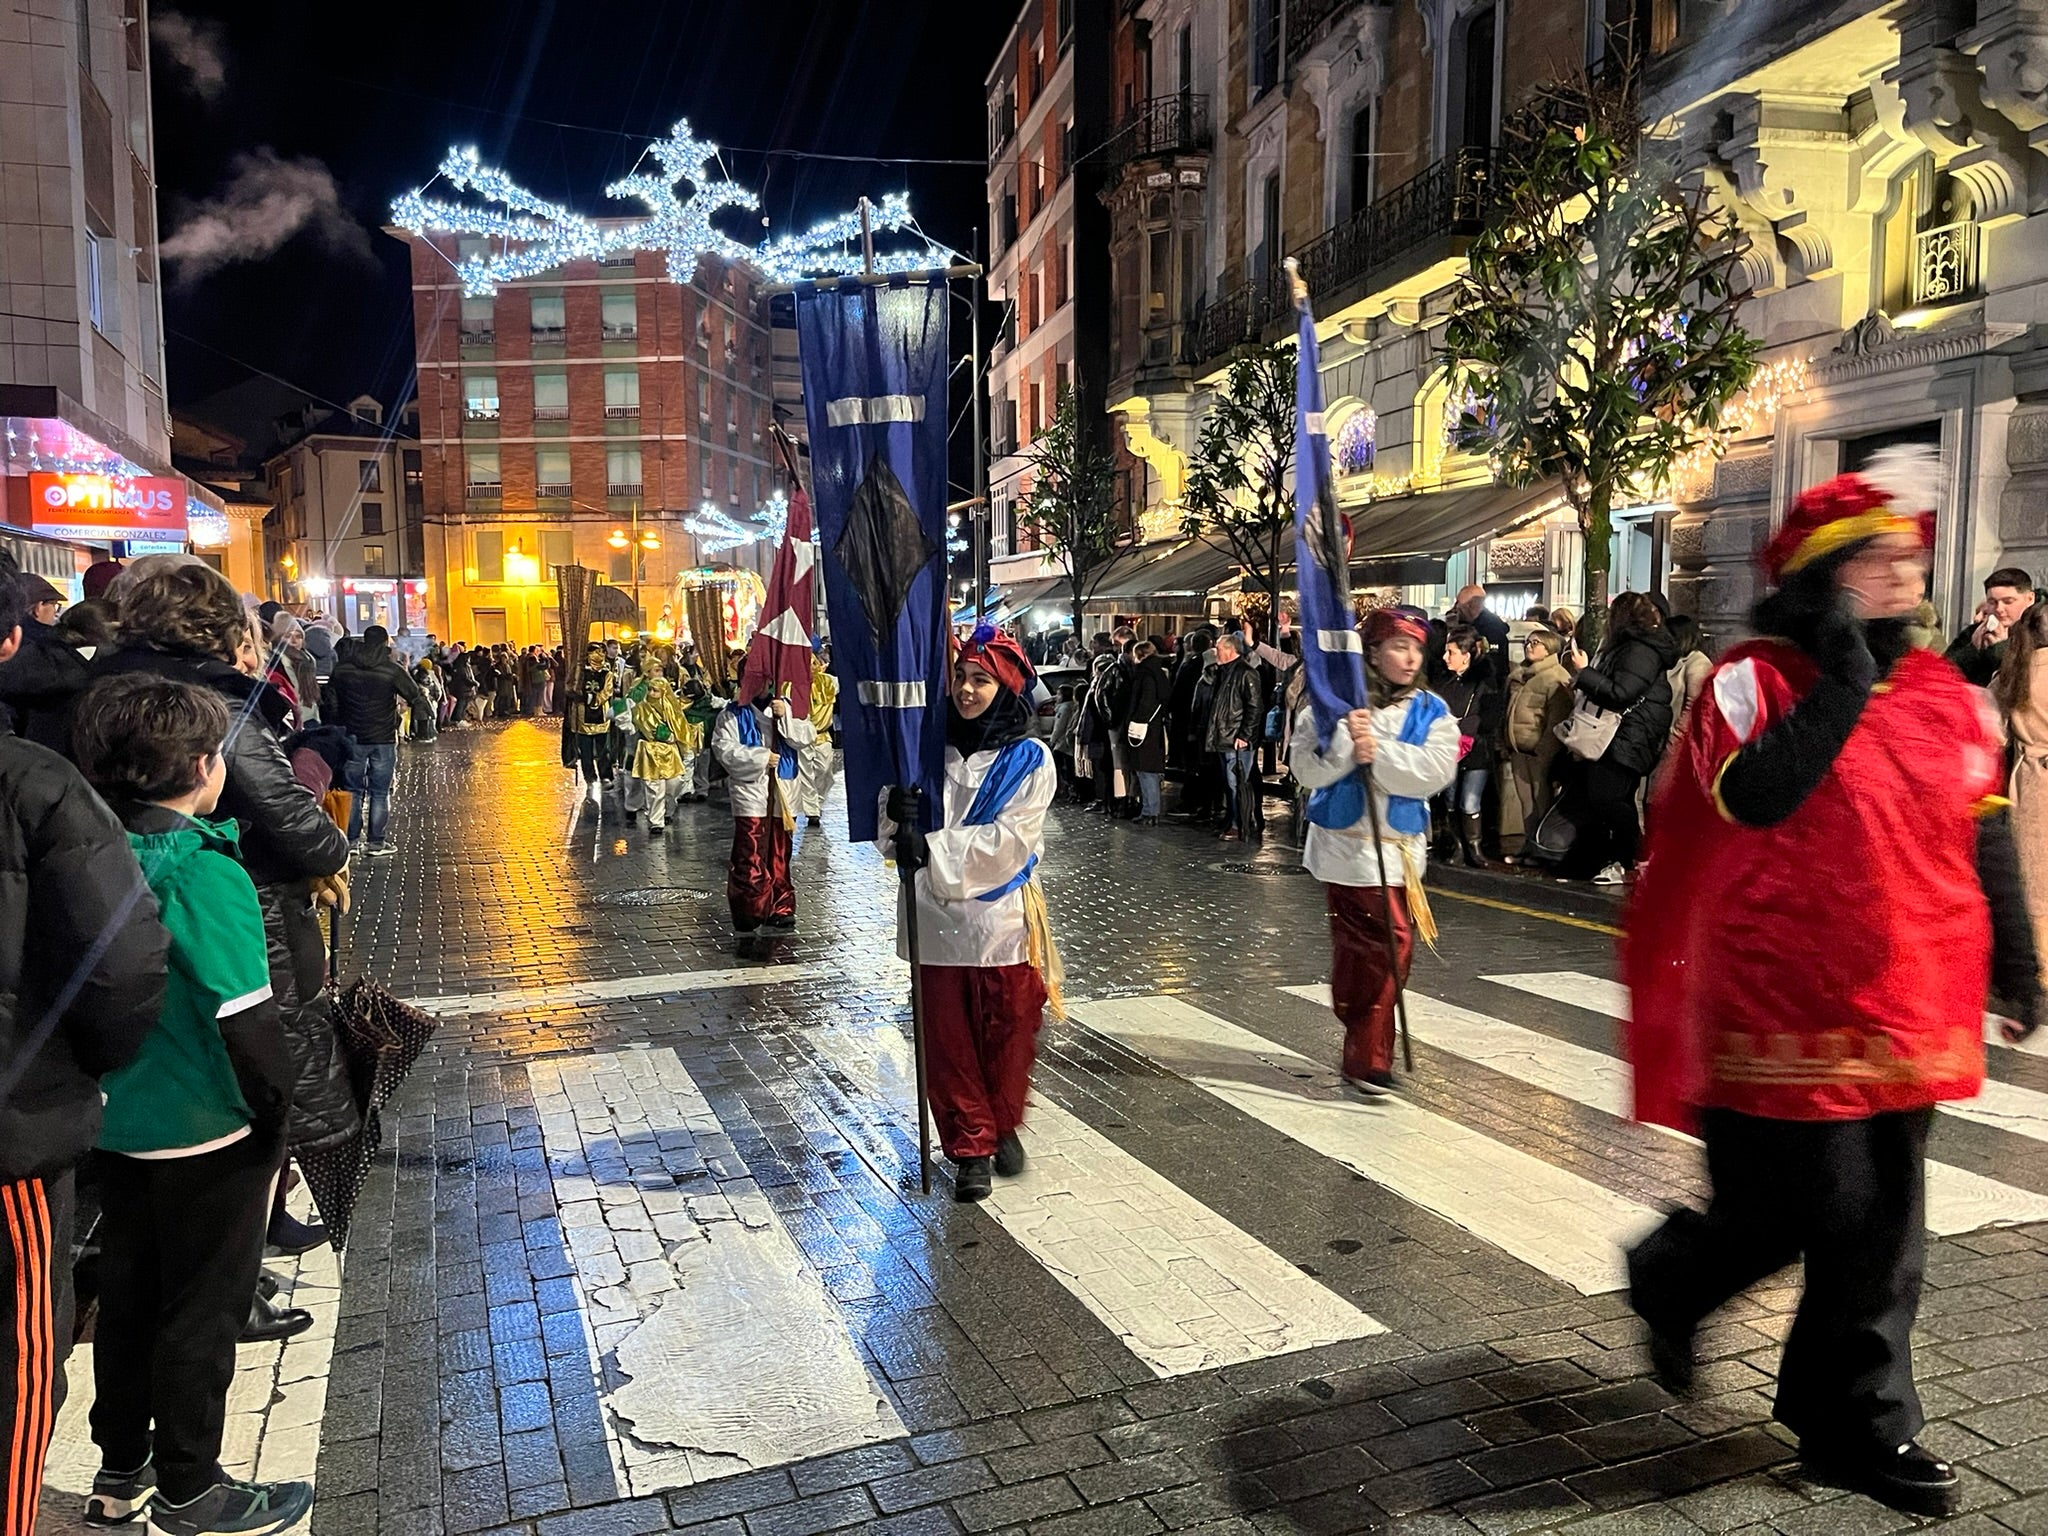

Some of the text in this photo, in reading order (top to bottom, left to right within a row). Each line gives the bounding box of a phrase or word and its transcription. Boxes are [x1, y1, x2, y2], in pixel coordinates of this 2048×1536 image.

[45, 486, 173, 510] OPTIMUS
[54, 528, 166, 540] COMERCIAL GONZALEZ
